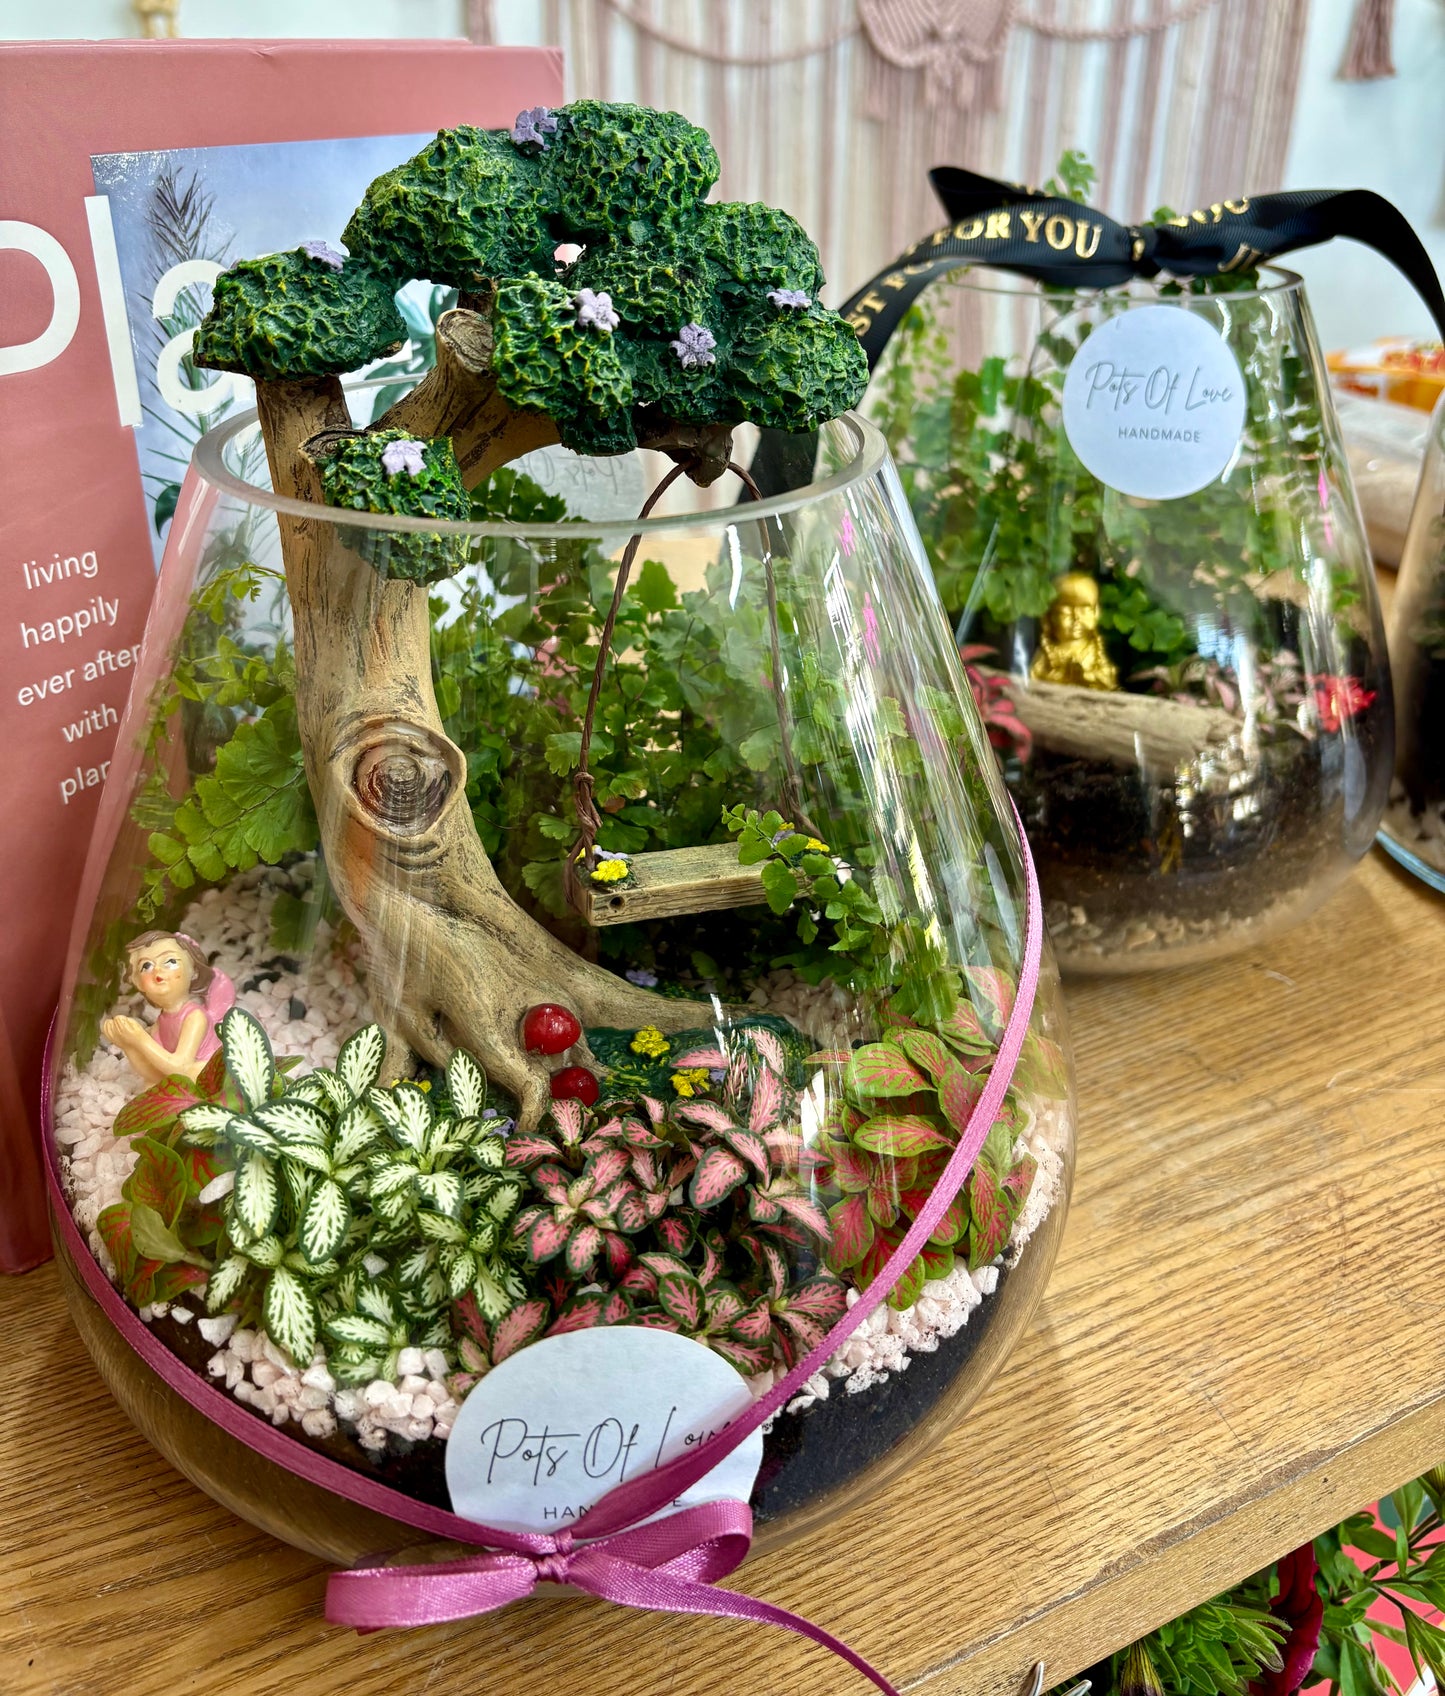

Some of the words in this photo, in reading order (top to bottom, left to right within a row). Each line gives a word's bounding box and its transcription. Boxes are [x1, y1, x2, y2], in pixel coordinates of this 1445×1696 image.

[1019, 210, 1102, 258] YOU
[1085, 362, 1145, 411] Pots
[1145, 365, 1180, 415] Of
[1185, 365, 1233, 411] Love
[1118, 427, 1201, 443] HANDMADE
[23, 551, 99, 590] living
[20, 596, 119, 648] happily
[18, 668, 75, 706] ever
[82, 644, 141, 682] after
[61, 703, 118, 743] with
[481, 1418, 581, 1486] Pots
[583, 1417, 639, 1482] Of
